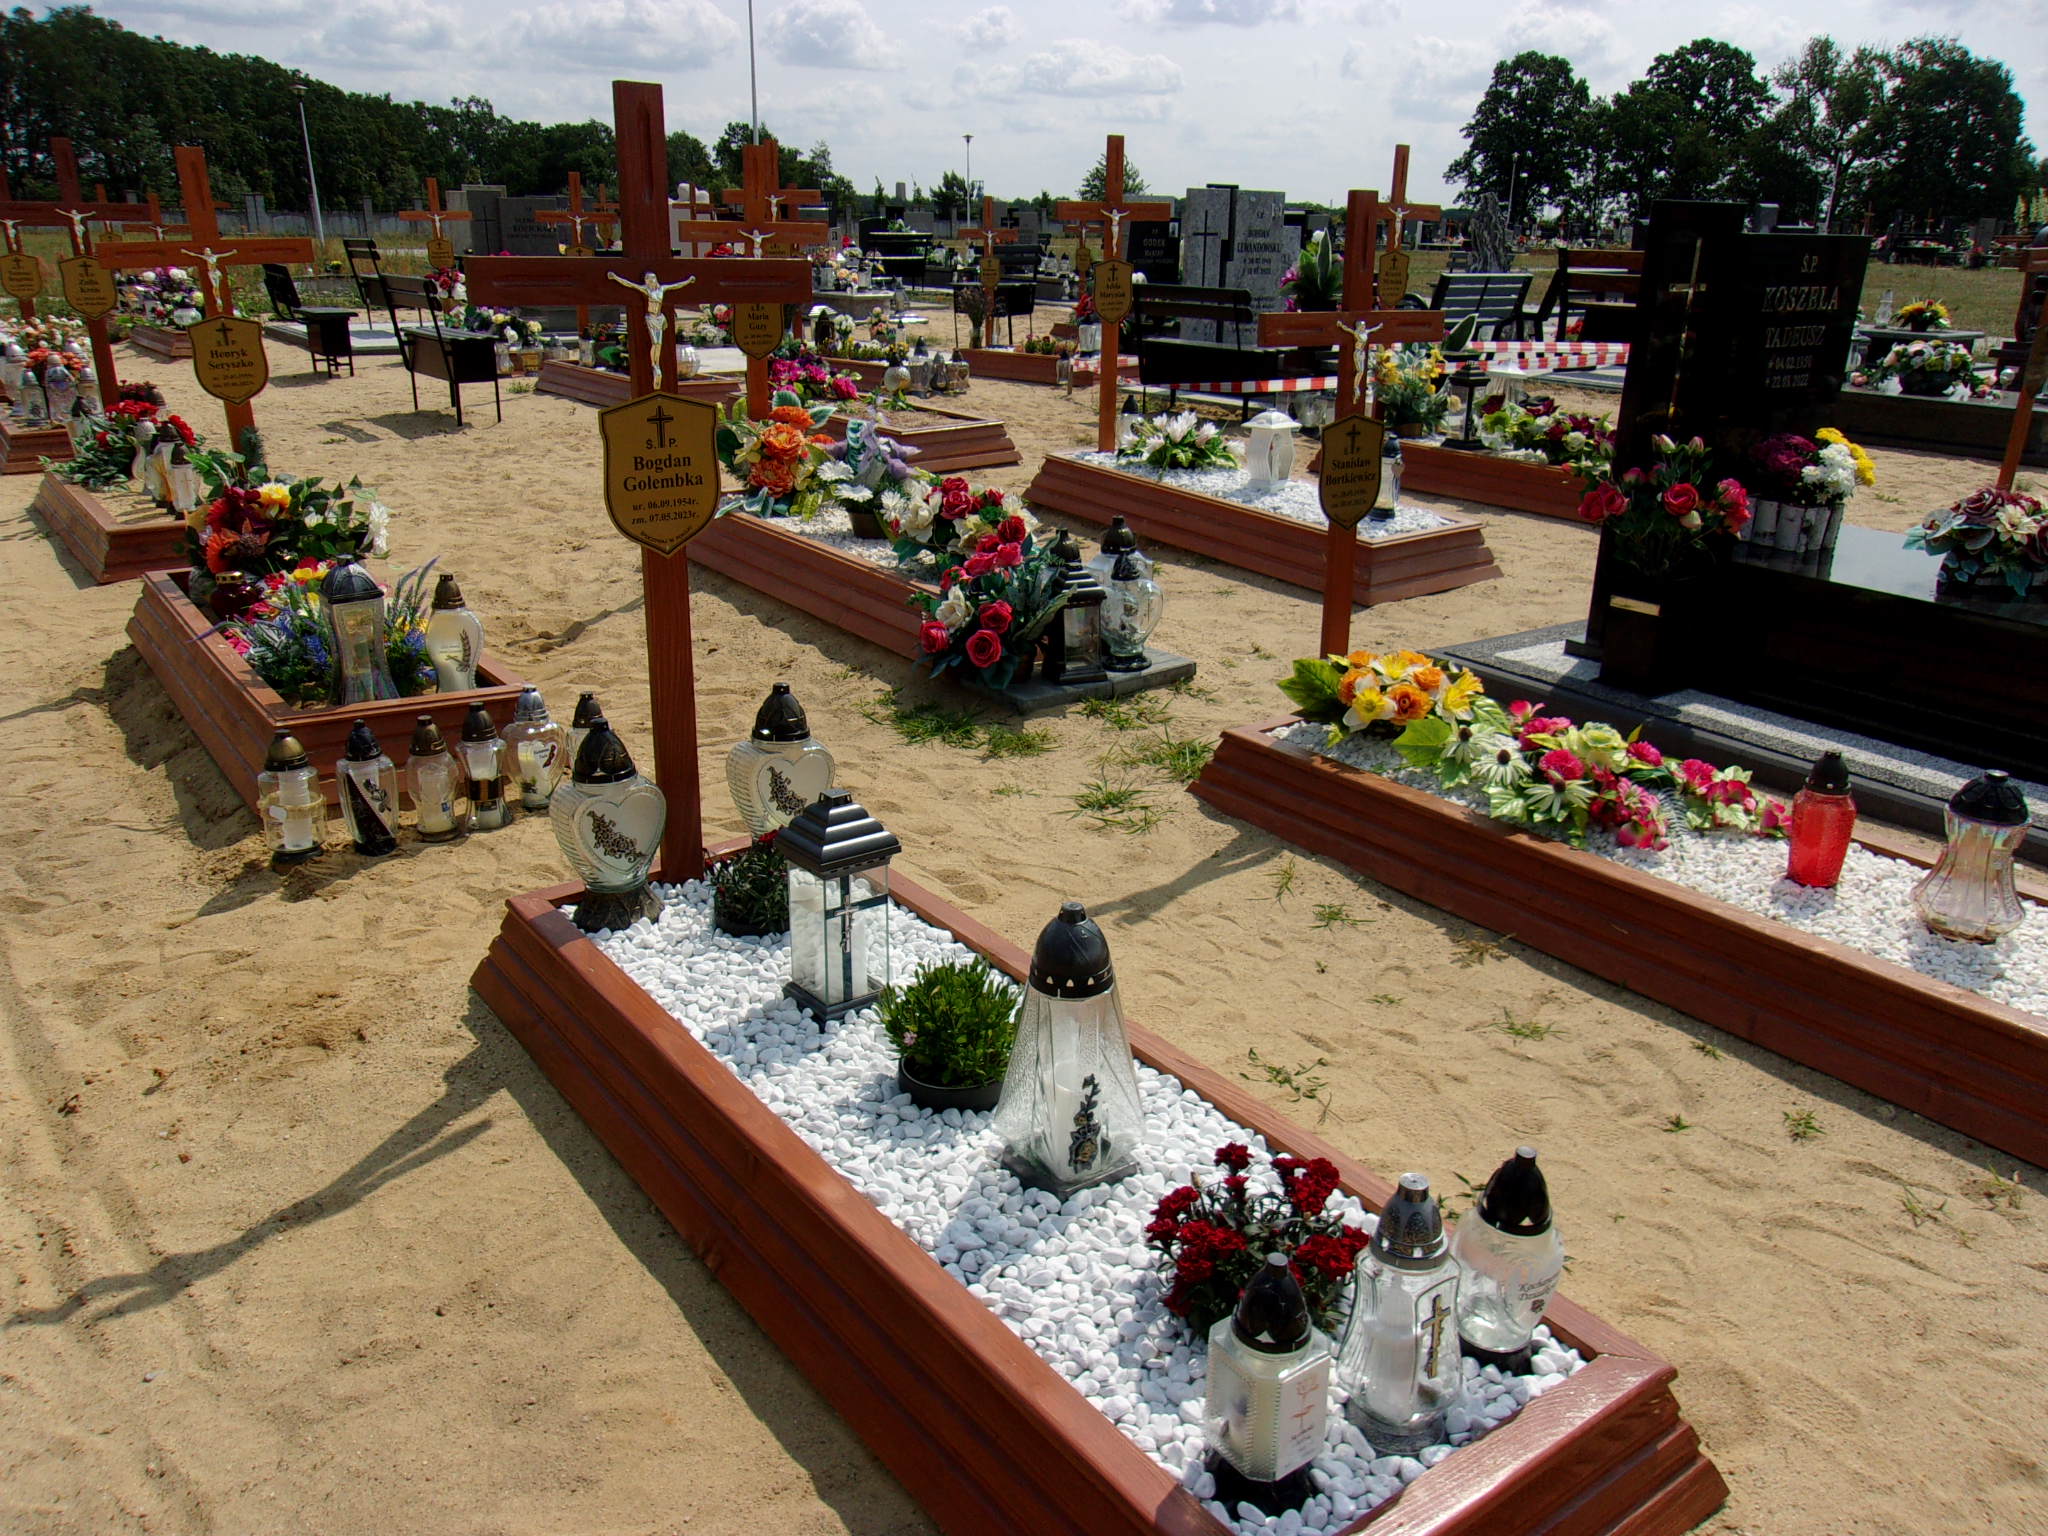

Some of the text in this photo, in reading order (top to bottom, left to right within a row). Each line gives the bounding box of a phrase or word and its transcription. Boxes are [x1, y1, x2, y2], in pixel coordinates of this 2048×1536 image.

[1762, 286, 1840, 312] KOSZELA
[1764, 325, 1827, 348] TADEUSZ
[210, 348, 249, 360] Henryk
[207, 359, 256, 371] Seryszko
[633, 453, 692, 474] Bogdan
[622, 471, 704, 493] Golembka
